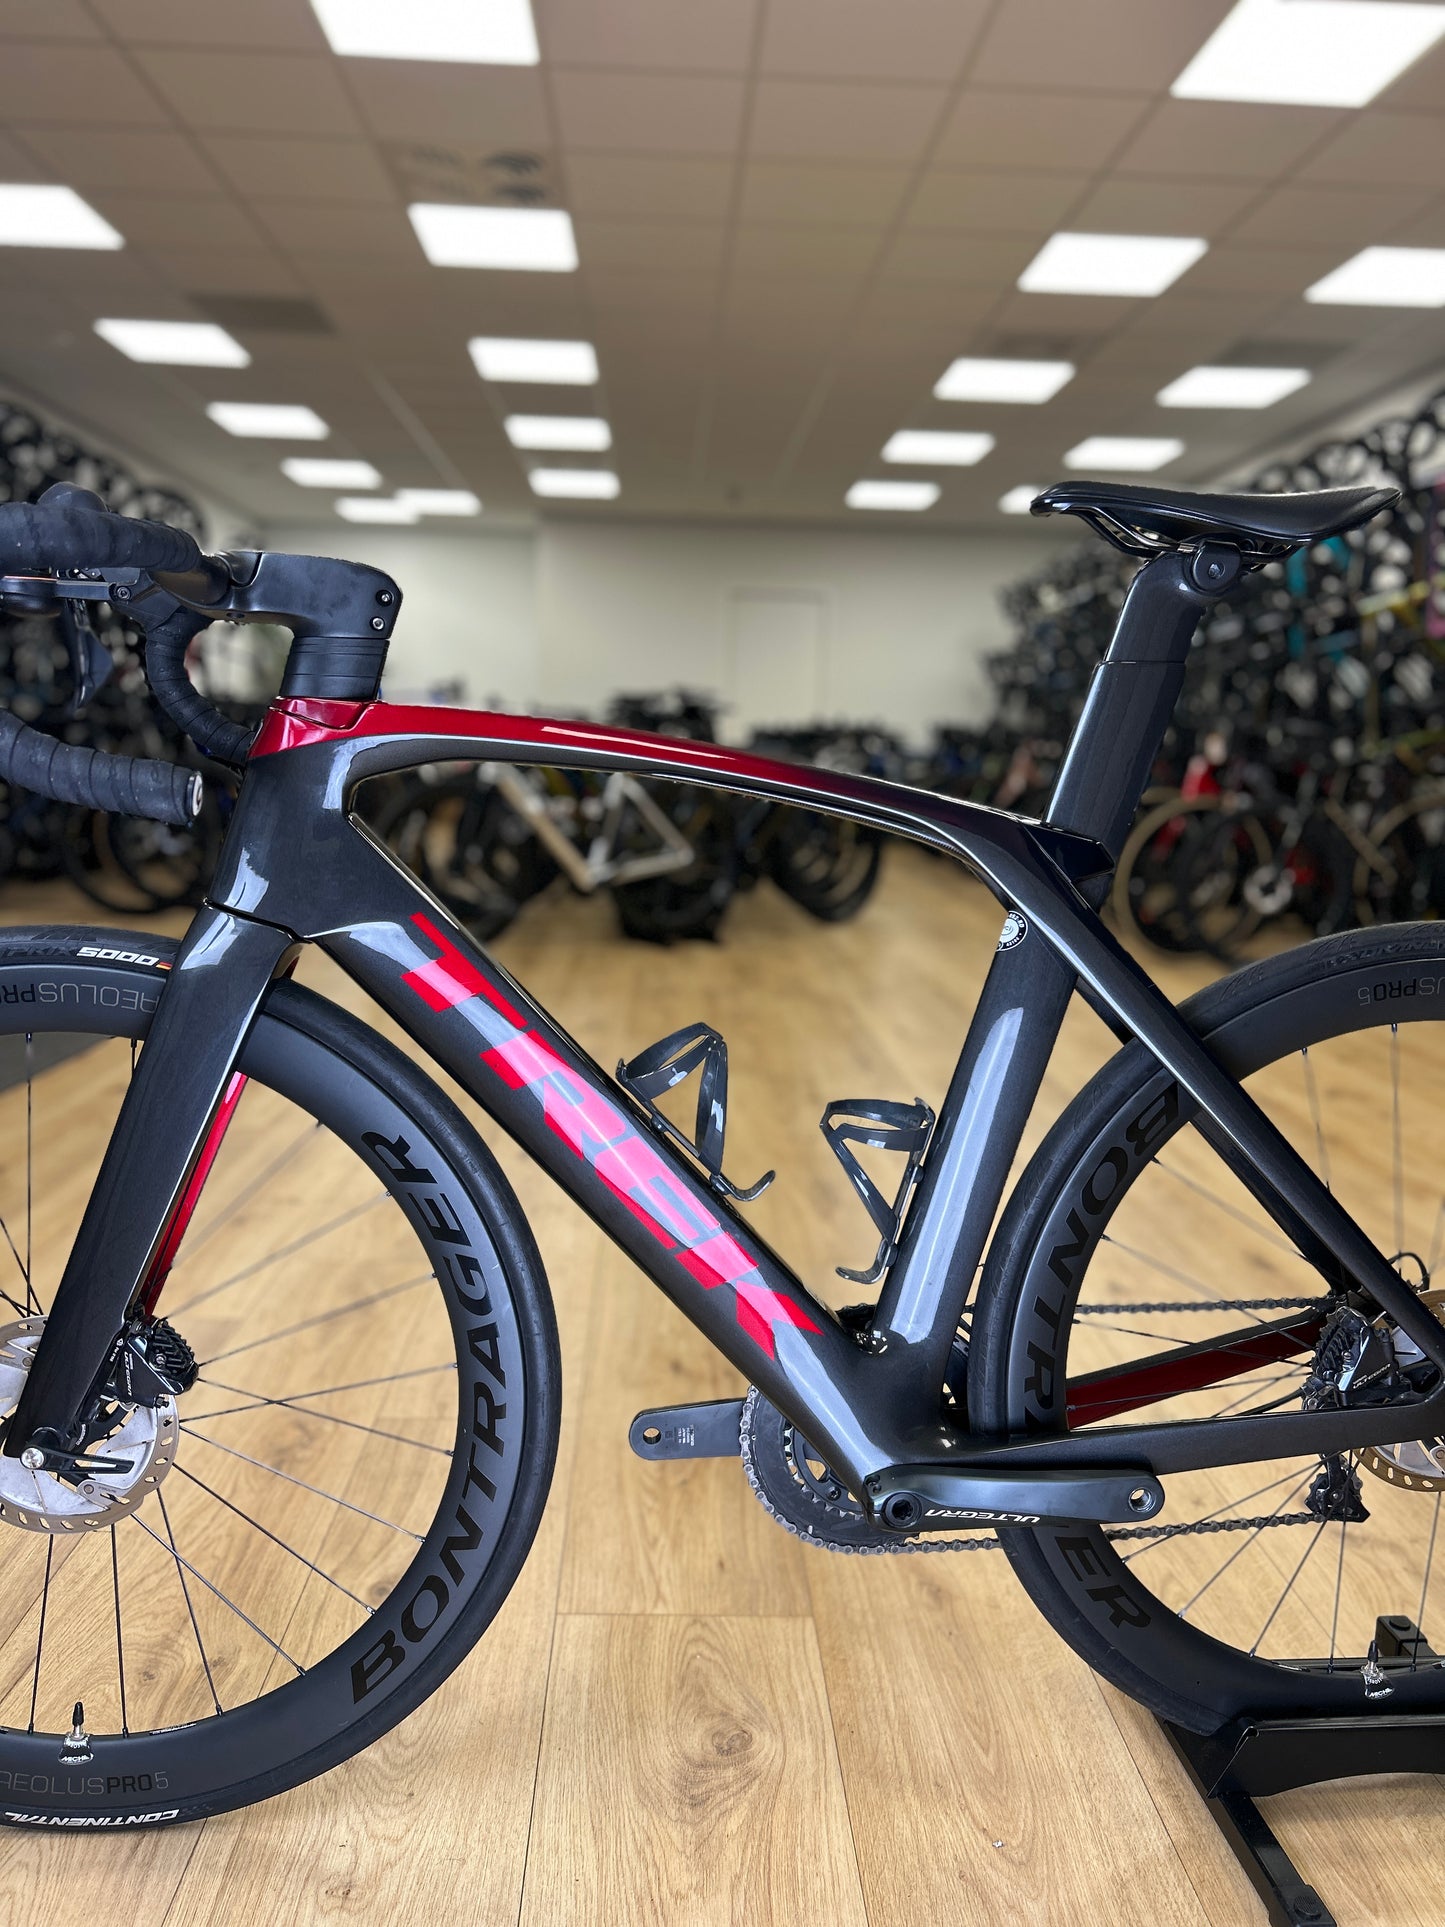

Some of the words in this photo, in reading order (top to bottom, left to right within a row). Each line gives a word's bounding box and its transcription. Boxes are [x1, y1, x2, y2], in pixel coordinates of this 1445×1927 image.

[76, 946, 160, 966] 5000
[401, 912, 824, 1361] TREK
[352, 1131, 507, 1704] BONTRAGER
[924, 1509, 1041, 1523] ULTEGRA
[5, 1809, 180, 1826] CONTINENTAL
